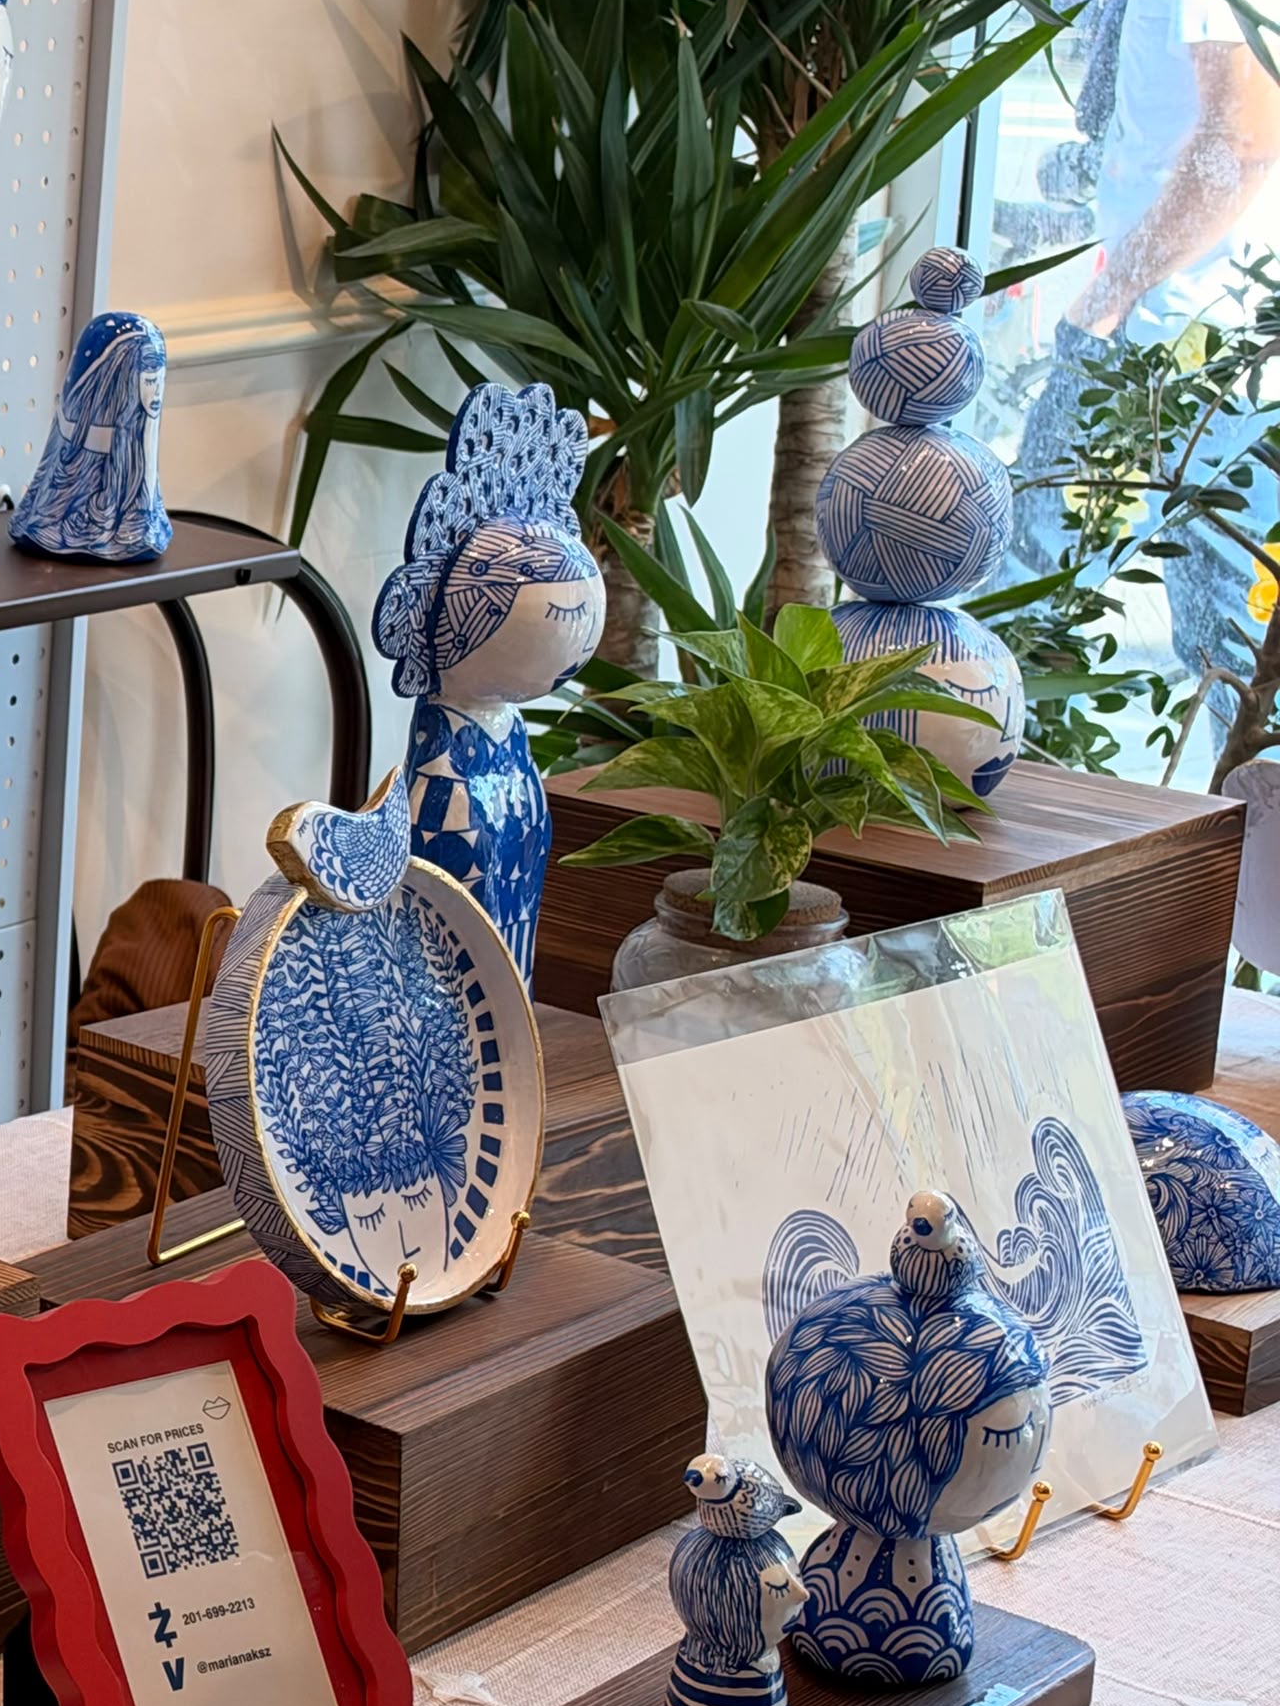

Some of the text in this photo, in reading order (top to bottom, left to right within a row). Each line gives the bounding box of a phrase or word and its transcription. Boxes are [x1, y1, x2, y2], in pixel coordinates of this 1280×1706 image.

[107, 1423, 205, 1454] SCAN FOR PRICES
[182, 1597, 255, 1626] 201-699-2213
[197, 1647, 272, 1674] @marianaksz
